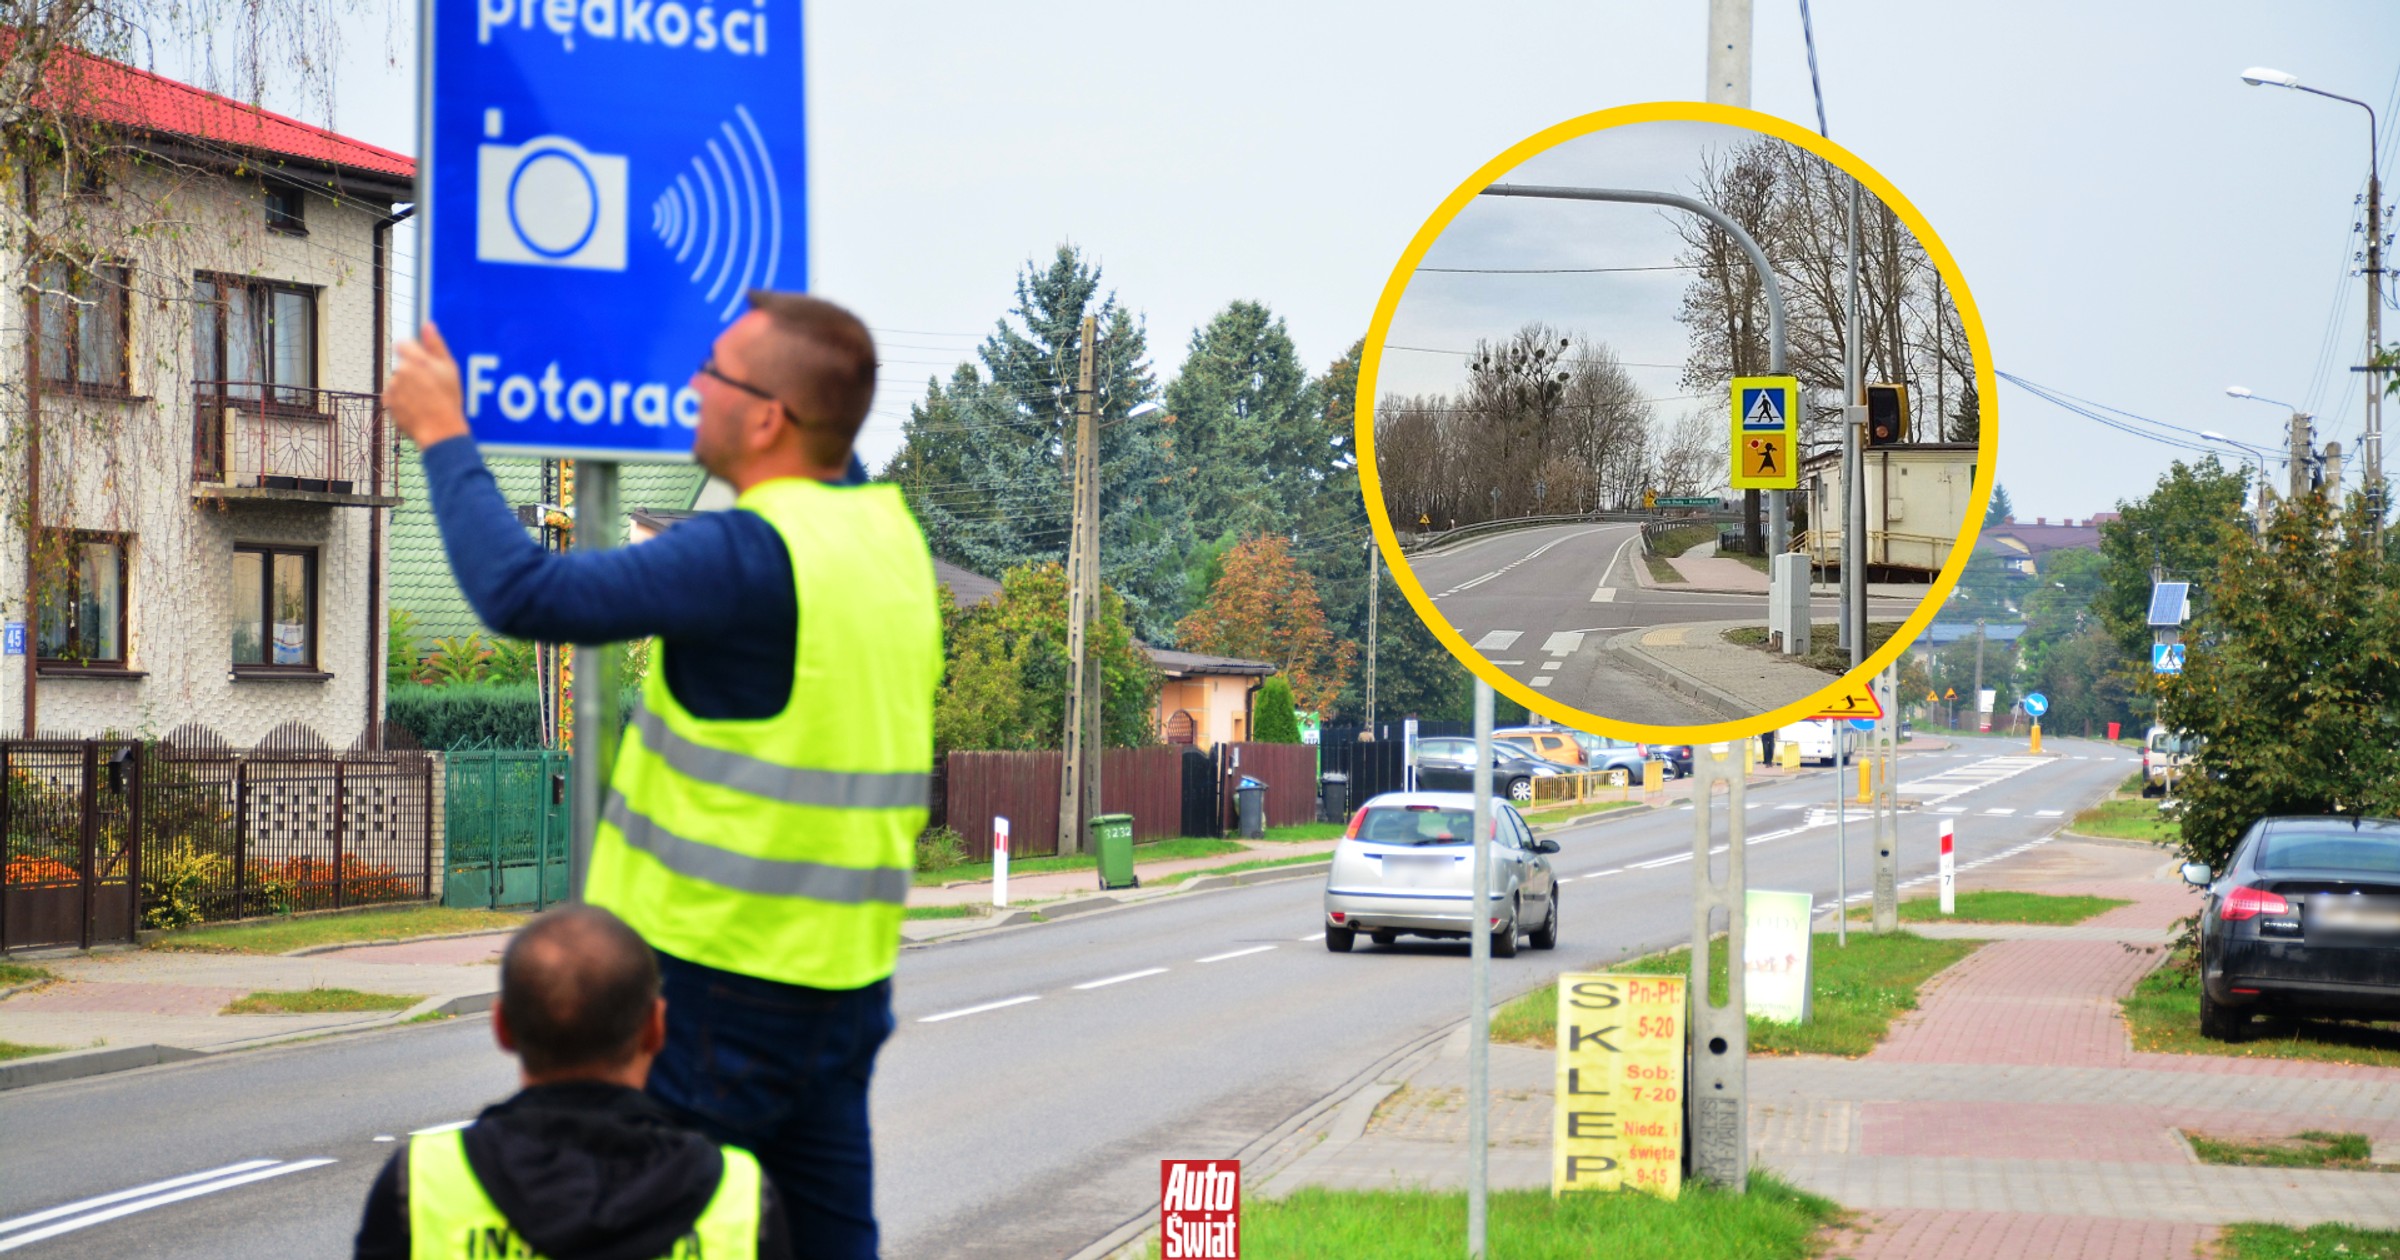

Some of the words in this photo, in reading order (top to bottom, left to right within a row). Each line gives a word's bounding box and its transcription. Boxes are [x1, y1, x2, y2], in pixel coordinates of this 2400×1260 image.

[8, 630, 22, 647] 45
[1103, 827, 1132, 840] 3232
[1944, 875, 1951, 886] 7
[1628, 980, 1681, 1004] Pn-Pt:
[1638, 1016, 1675, 1039] 5-20
[1626, 1065, 1676, 1081] Sob:
[1566, 982, 1623, 1183] SKLEP
[1632, 1087, 1677, 1102] 7-20
[1623, 1121, 1668, 1137] Niedz.
[1673, 1121, 1678, 1136] i
[1629, 1145, 1676, 1163] święta
[1637, 1168, 1668, 1184] 9-15
